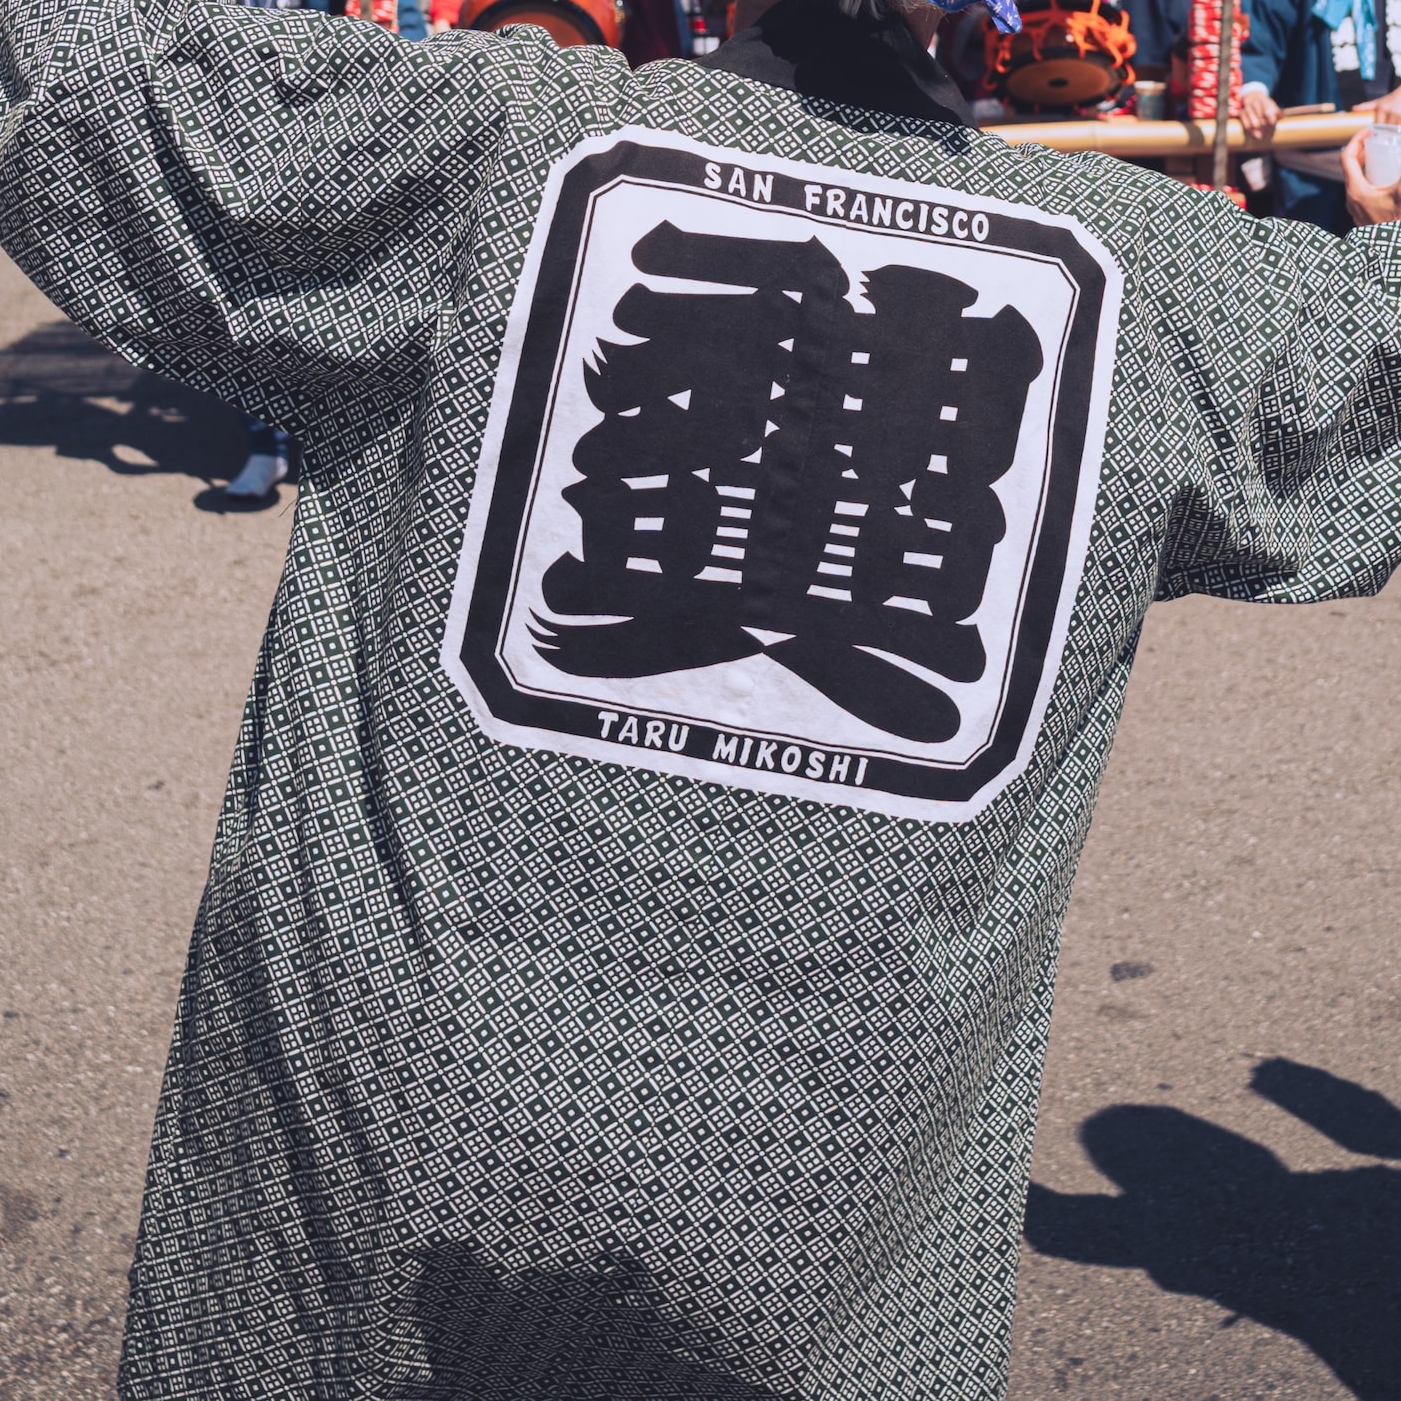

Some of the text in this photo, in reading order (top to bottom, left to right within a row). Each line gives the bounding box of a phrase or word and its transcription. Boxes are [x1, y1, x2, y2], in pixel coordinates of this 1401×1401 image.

[703, 161, 991, 244] SAN FRANCISCO
[597, 709, 870, 785] TARU MIKOSHI
